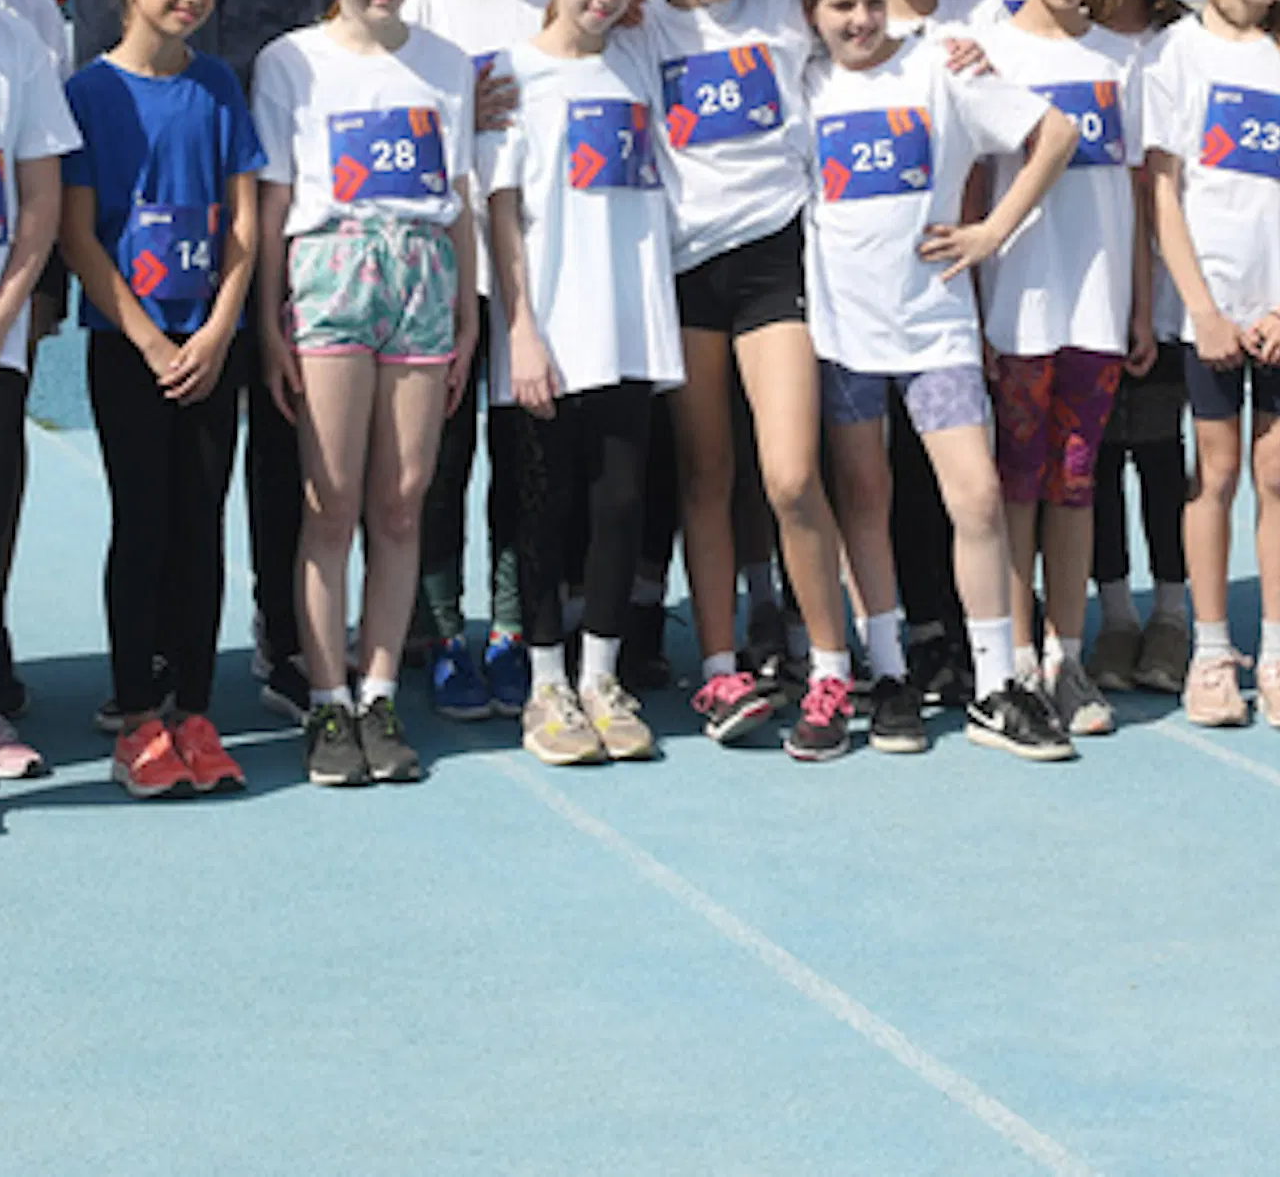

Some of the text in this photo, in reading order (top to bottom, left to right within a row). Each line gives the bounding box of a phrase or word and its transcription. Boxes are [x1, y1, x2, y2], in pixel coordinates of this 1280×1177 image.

[696, 79, 742, 115] 26
[370, 138, 416, 172] 28
[616, 129, 634, 160] 7
[851, 138, 895, 172] 25
[175, 240, 211, 271] 14
